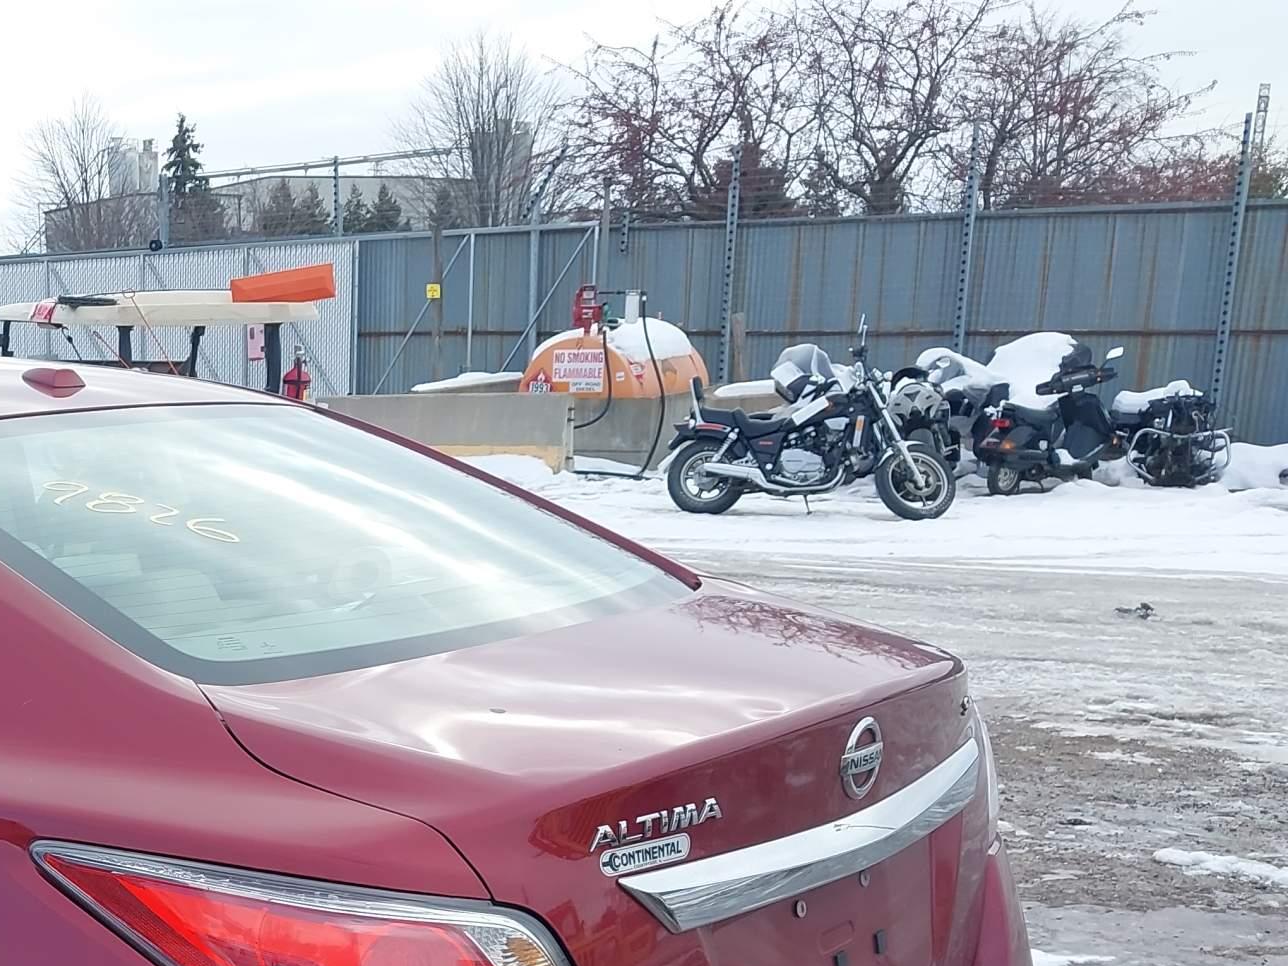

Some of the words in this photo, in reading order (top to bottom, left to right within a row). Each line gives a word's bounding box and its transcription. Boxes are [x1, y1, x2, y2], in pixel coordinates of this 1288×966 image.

[554, 351, 565, 363] NO
[567, 351, 603, 363] SMOKING
[554, 367, 602, 379] FLAMMABLE
[590, 797, 723, 853] ALTIMA
[611, 840, 683, 871] CONTINENTAL
